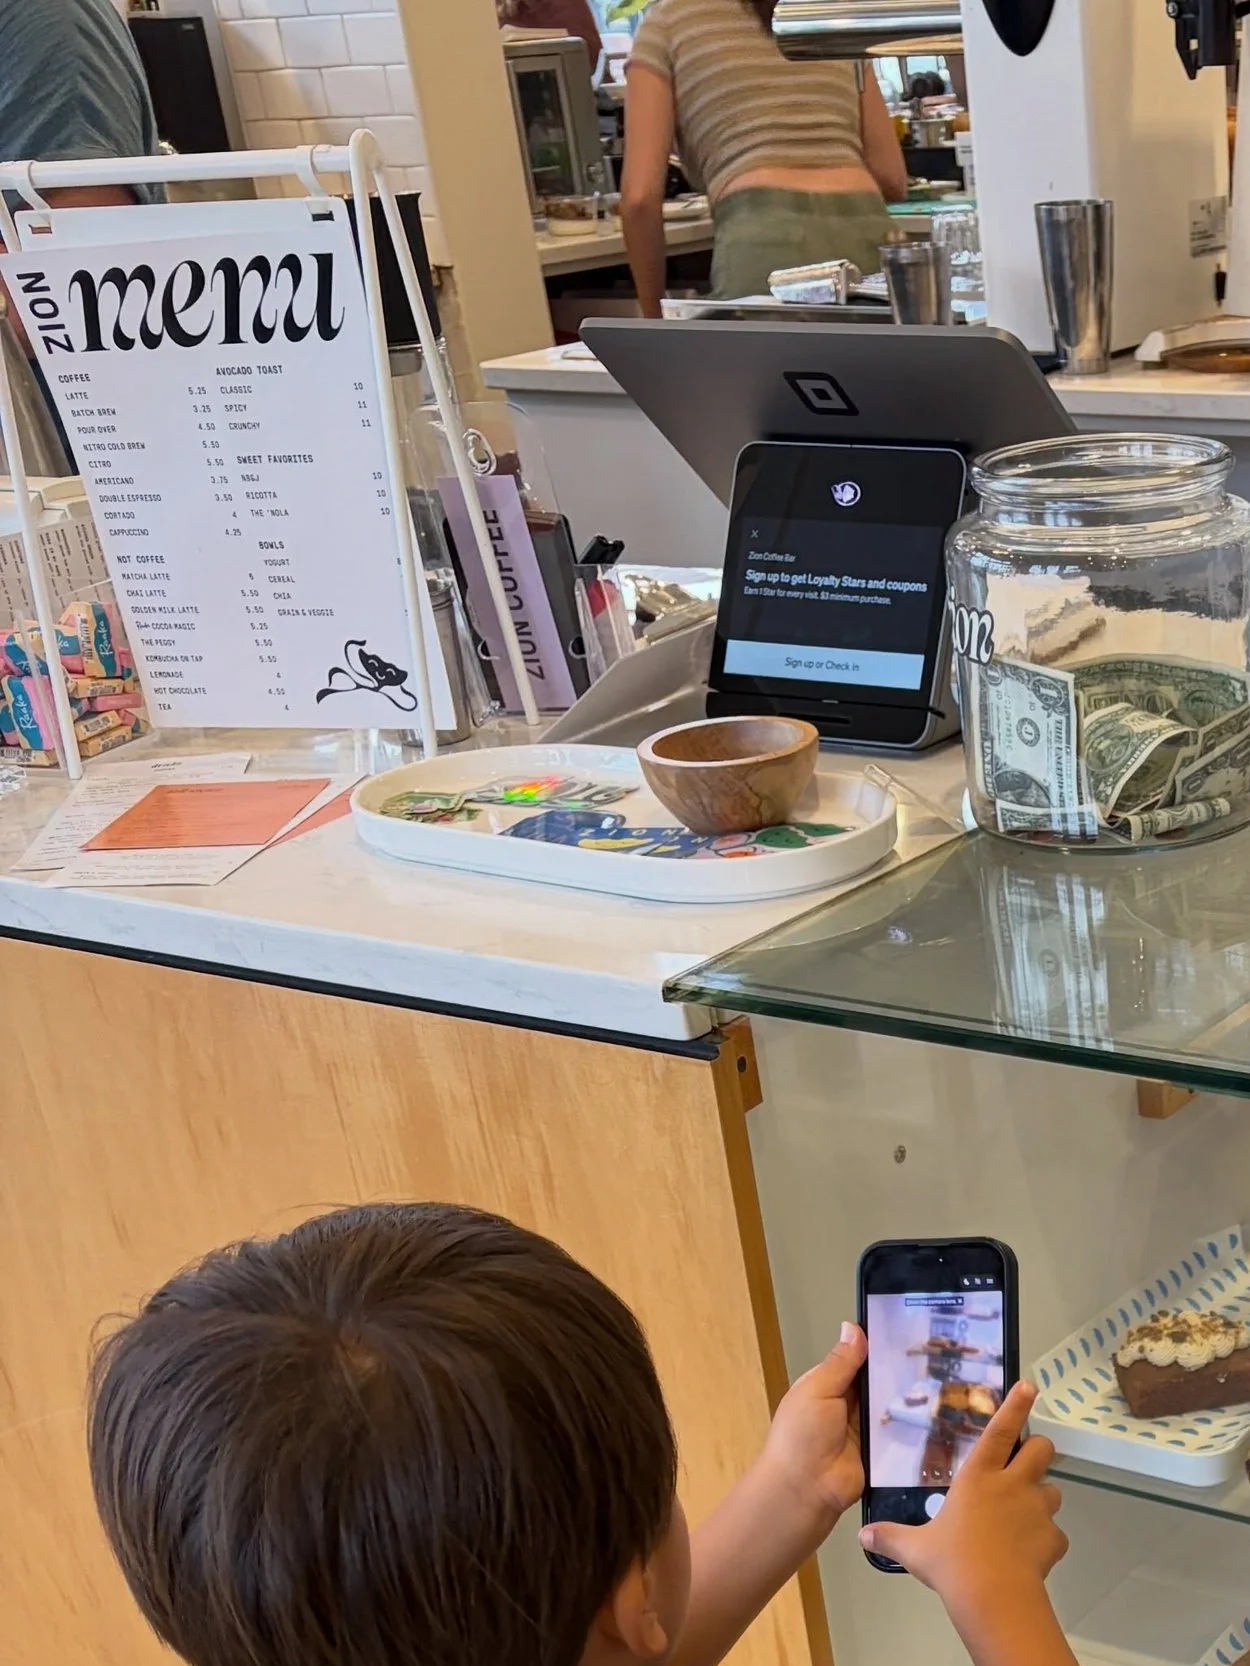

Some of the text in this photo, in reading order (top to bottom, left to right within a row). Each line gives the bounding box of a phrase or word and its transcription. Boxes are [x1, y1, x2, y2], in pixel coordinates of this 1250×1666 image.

[68, 252, 345, 352] menu
[16, 272, 76, 354] ZION
[216, 365, 283, 376] AVOCADO TOAST
[59, 374, 91, 384] COFFEE
[220, 382, 364, 394] CLASSIC 10
[65, 387, 207, 401] LATTE 5.25
[224, 401, 368, 413] SPICY 11
[71, 409, 95, 418] BATCH
[97, 408, 117, 417] BREW
[77, 426, 97, 435] POUR
[98, 425, 117, 434] OVER
[229, 419, 372, 431] CRUNCHY 11
[83, 441, 220, 452] NITRO COLD BREW 5.50
[88, 460, 112, 469] CITRO
[237, 454, 314, 465] SWEET FAVORITES
[373, 472, 383, 480] 10
[95, 477, 135, 486] AMERICANO
[99, 495, 125, 503] DOUBLE
[127, 494, 162, 502] ESPRESSO
[246, 489, 387, 500] RICOTTA 10
[104, 512, 136, 520] CORTADO
[251, 509, 264, 517] THE
[381, 507, 391, 516] 10
[109, 529, 149, 537] CAPPUCCINO
[259, 541, 285, 550] BOWLS
[117, 555, 166, 564] NOT COFFEE
[749, 551, 763, 561] Zion
[264, 558, 290, 567] YOGURT
[122, 573, 171, 581] MATCHA LATTE
[268, 575, 296, 584] CEREAL
[745, 569, 928, 593] Sign up to get Loyalty Stars and coupons
[127, 589, 144, 598] CHAI
[145, 589, 167, 598] LATTE
[273, 592, 292, 600] CHIA
[178, 606, 200, 614] LATTE
[141, 639, 155, 647] THE
[784, 657, 860, 672] Sign up or Check in
[158, 703, 172, 711] TEA
